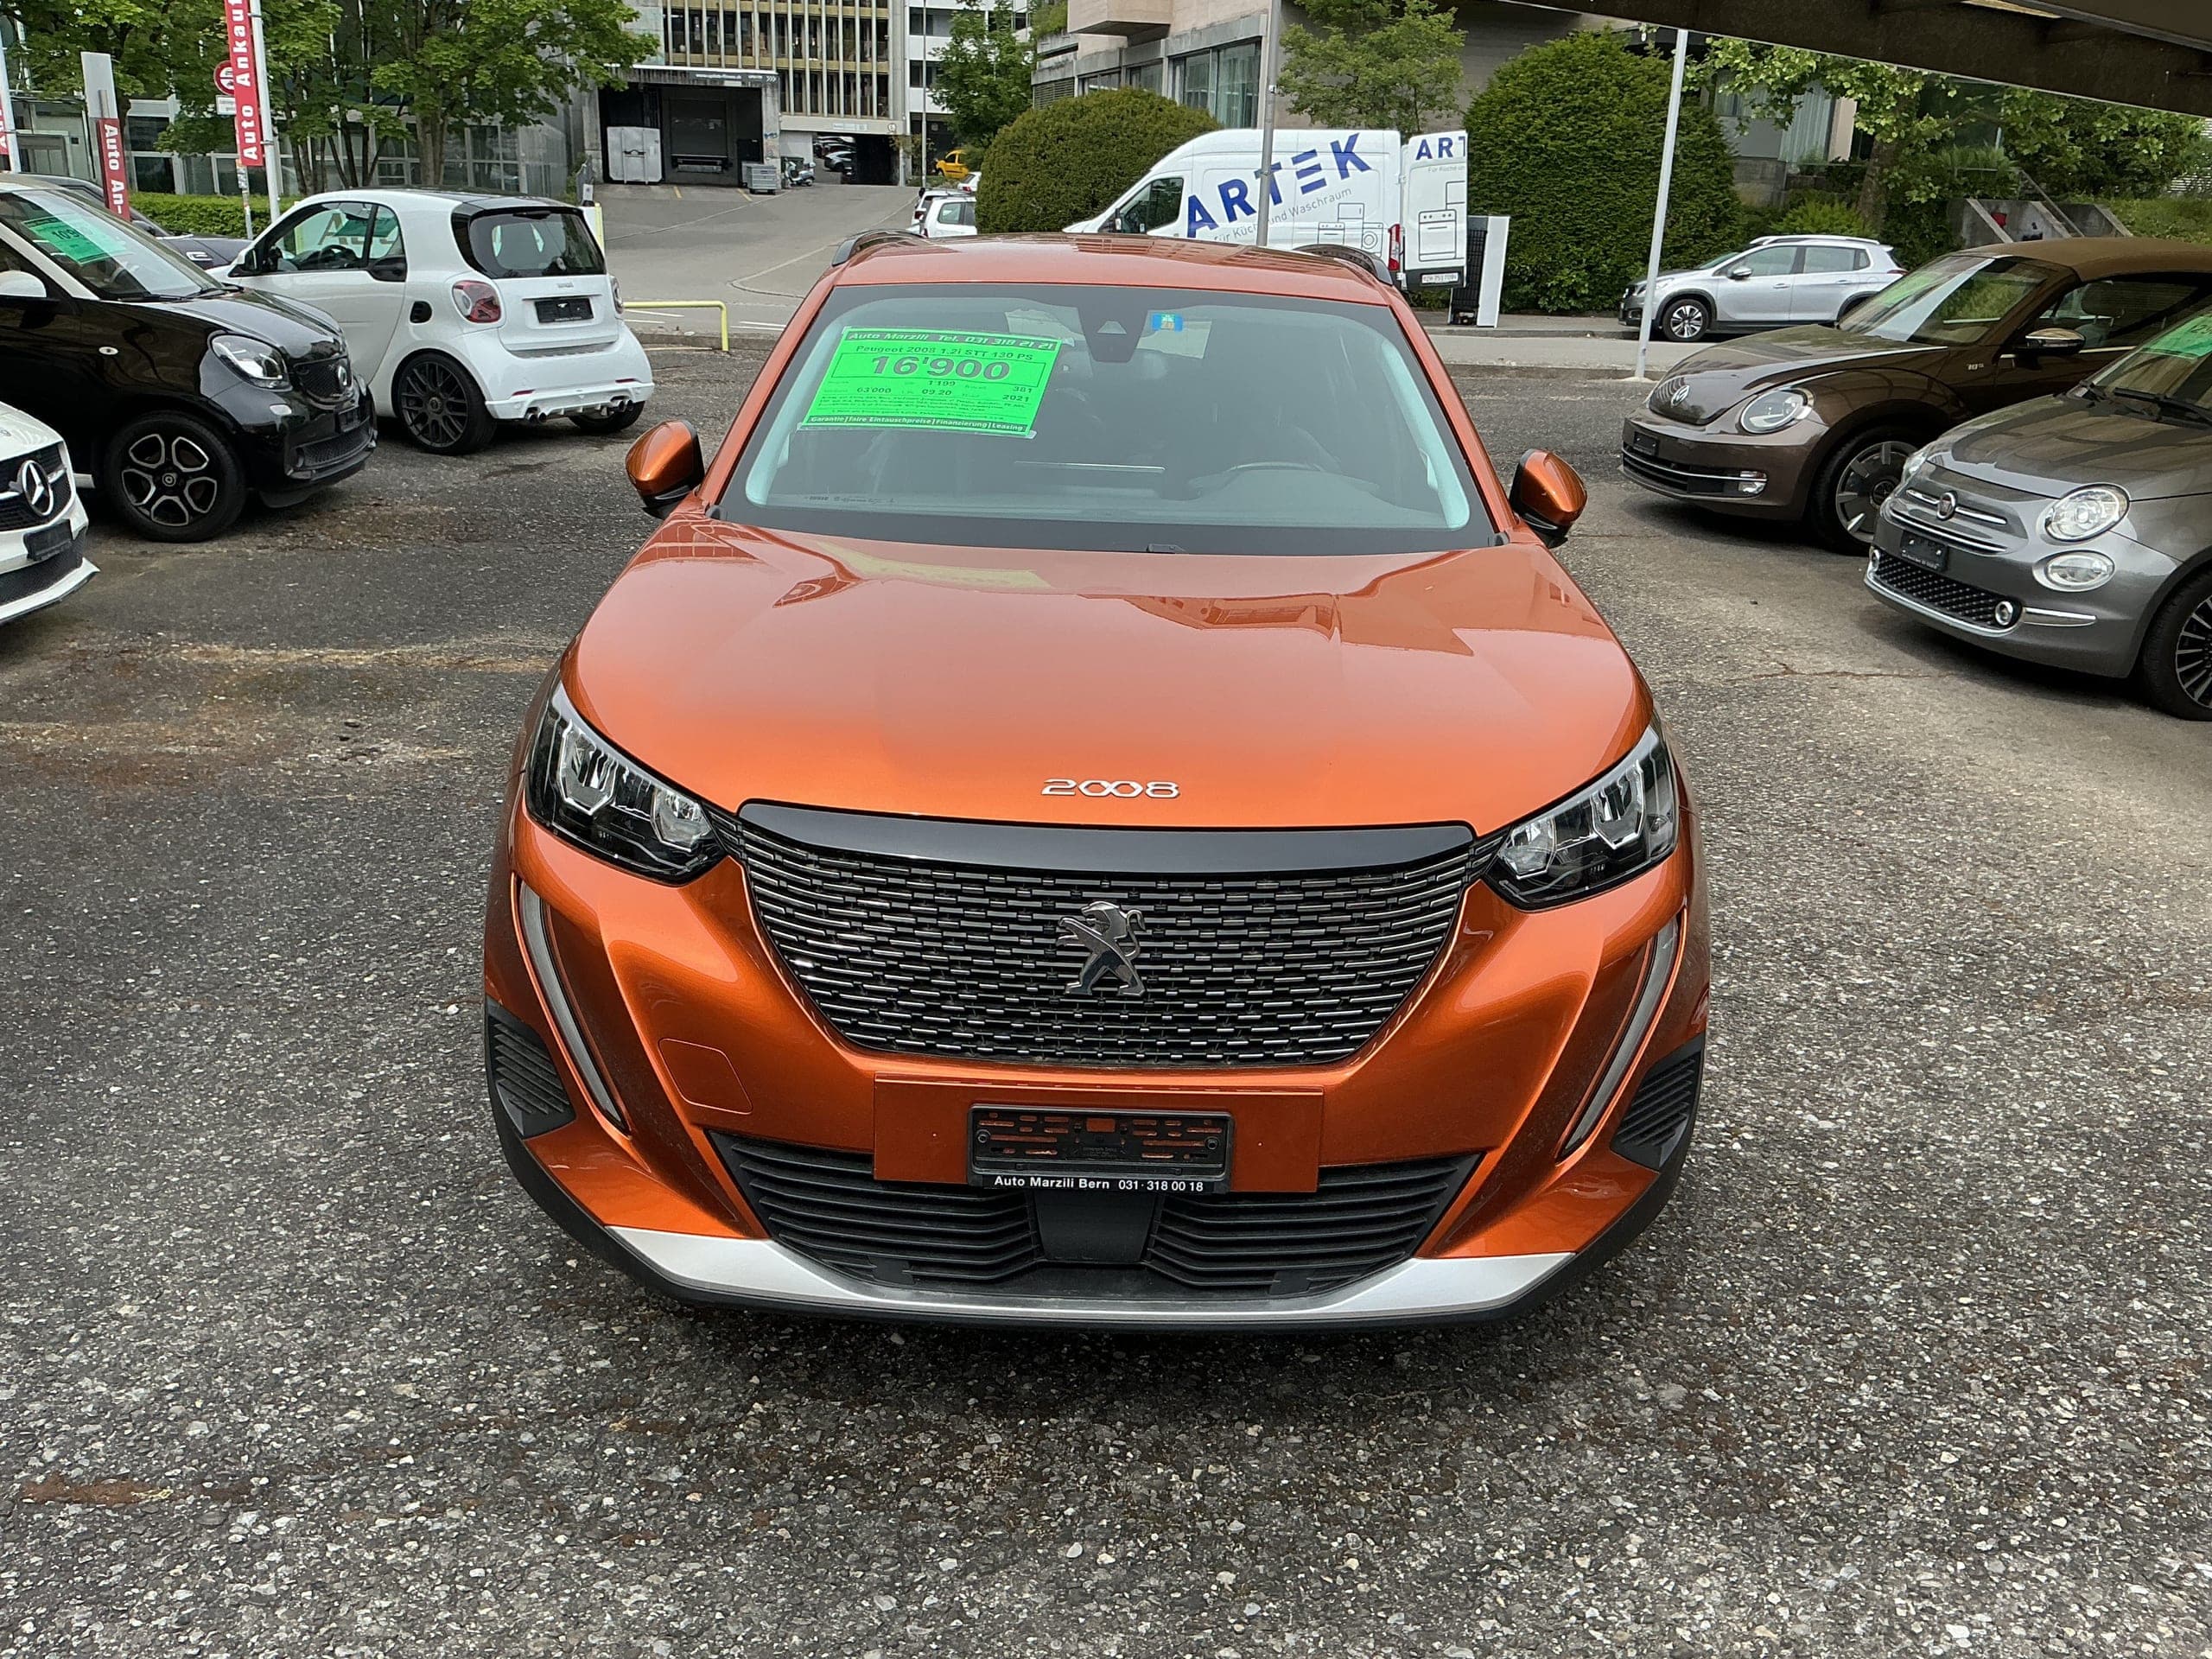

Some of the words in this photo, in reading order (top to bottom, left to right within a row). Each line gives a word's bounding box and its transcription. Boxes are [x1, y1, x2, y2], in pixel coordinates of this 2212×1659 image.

[105, 124, 120, 171] Auto
[241, 105, 257, 161] Auto
[1187, 133, 1371, 238] ARTEK
[1287, 187, 1352, 218] Waschraum
[872, 356, 1010, 380] 16'900
[1041, 779, 1181, 798] 2008
[994, 1176, 1025, 1186] Auto
[1030, 1177, 1074, 1187] Marzili
[1078, 1179, 1110, 1189] Bern
[1171, 1181, 1186, 1192] 00
[1189, 1182, 1204, 1192] 18
